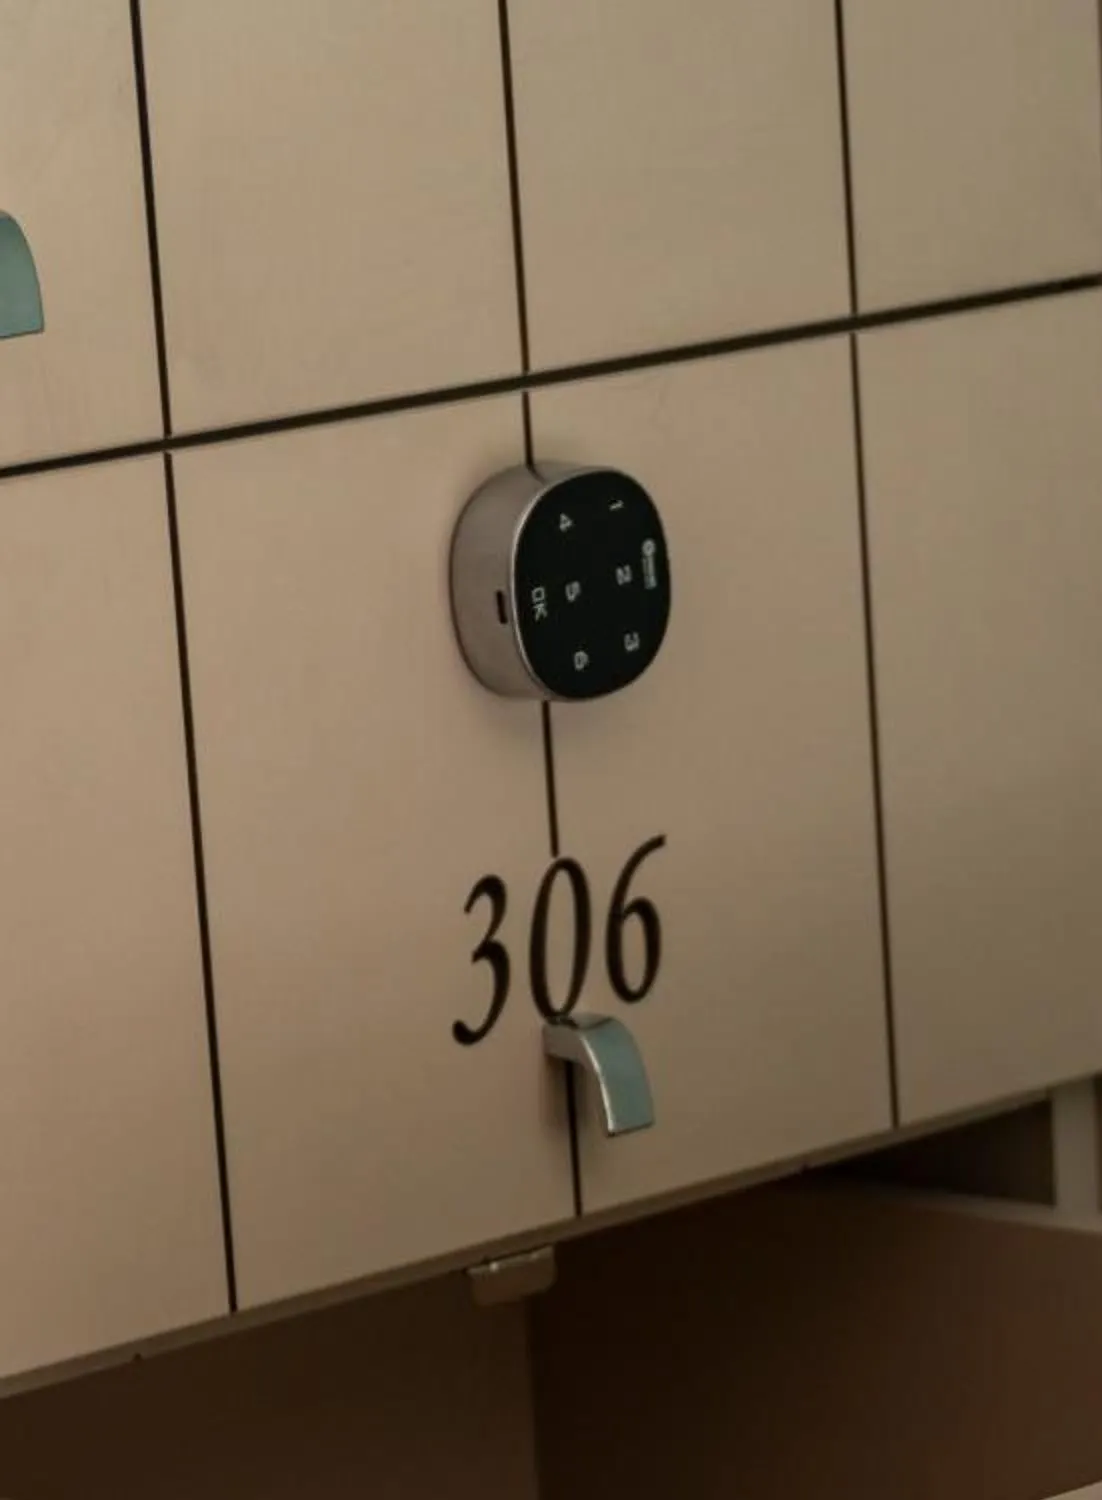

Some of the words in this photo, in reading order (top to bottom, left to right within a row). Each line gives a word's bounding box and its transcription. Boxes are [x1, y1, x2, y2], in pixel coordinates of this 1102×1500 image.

[558, 512, 574, 533] 4
[530, 585, 549, 622] OK
[564, 580, 582, 603] 5
[452, 834, 666, 1046] 306
